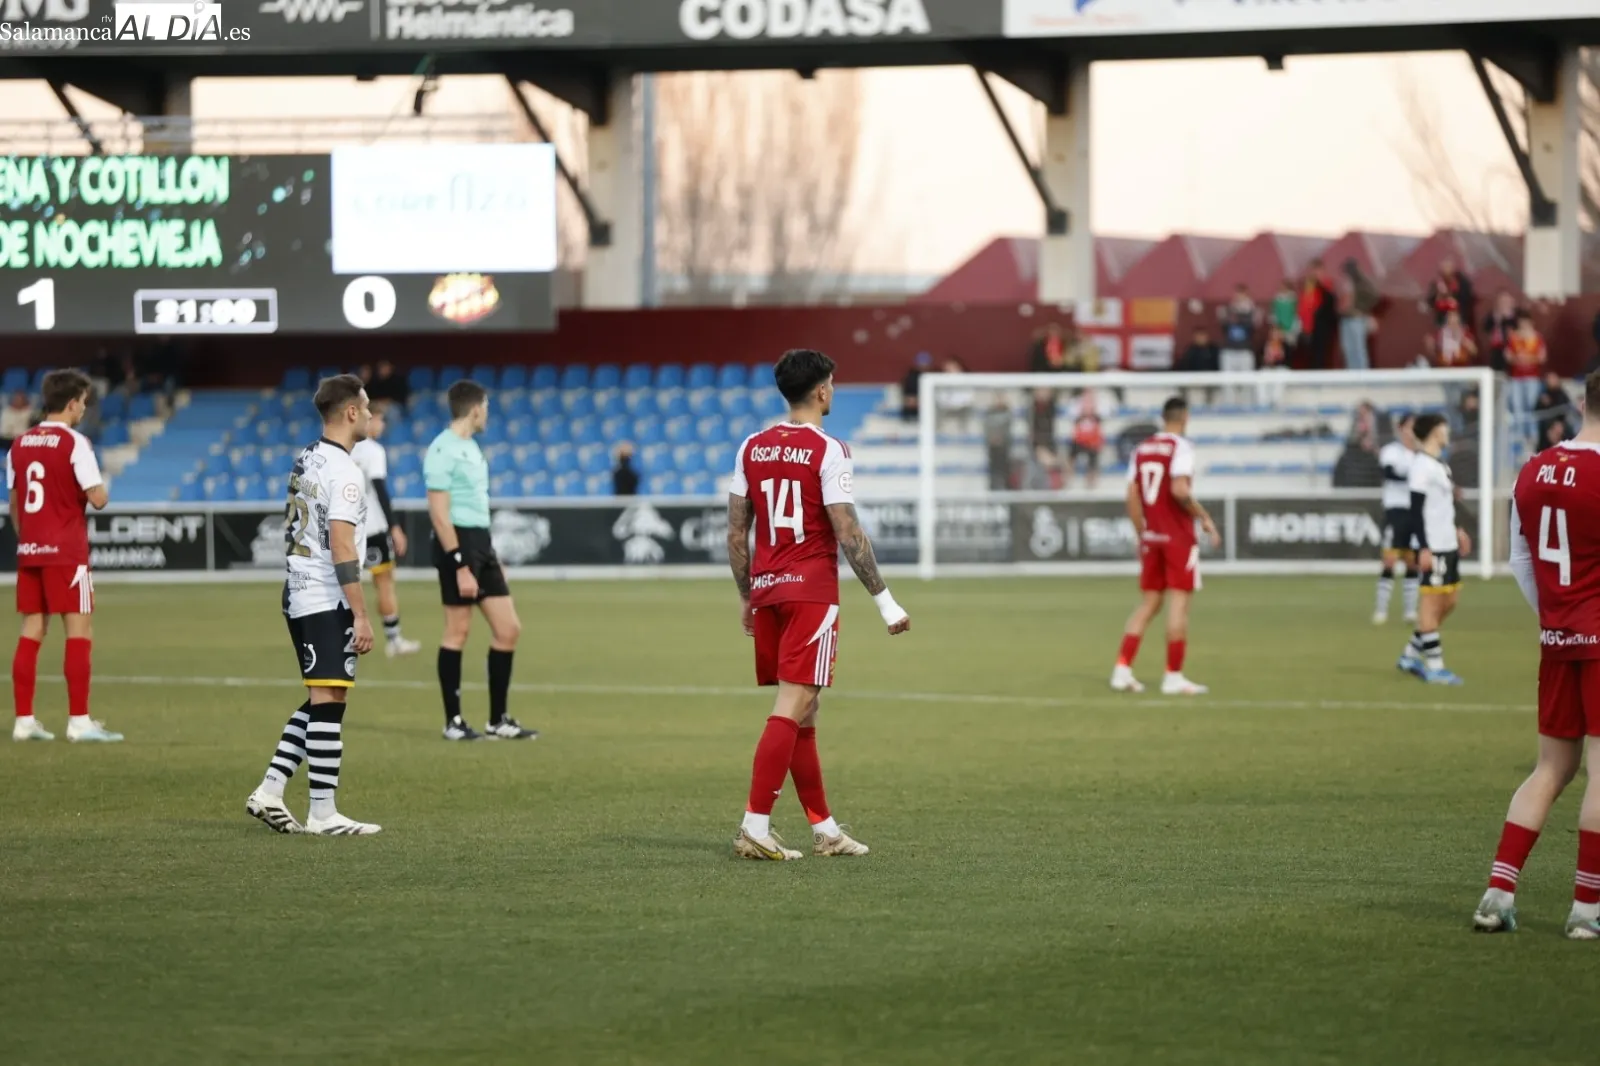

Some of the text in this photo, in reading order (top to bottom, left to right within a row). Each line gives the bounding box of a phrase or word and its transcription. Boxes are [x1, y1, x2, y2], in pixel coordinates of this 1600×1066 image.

[679, 0, 931, 40] CODASA
[52, 156, 76, 204] Y
[79, 156, 229, 204] COTILLON
[33, 219, 223, 268] NOCHEVIEJA
[17, 277, 55, 330] 1
[342, 276, 396, 329] 0
[751, 444, 813, 465] ÓSCAR SANZ
[1536, 465, 1557, 484] POL
[24, 461, 45, 513] 6
[760, 478, 805, 546] 14
[1538, 505, 1571, 586] 4
